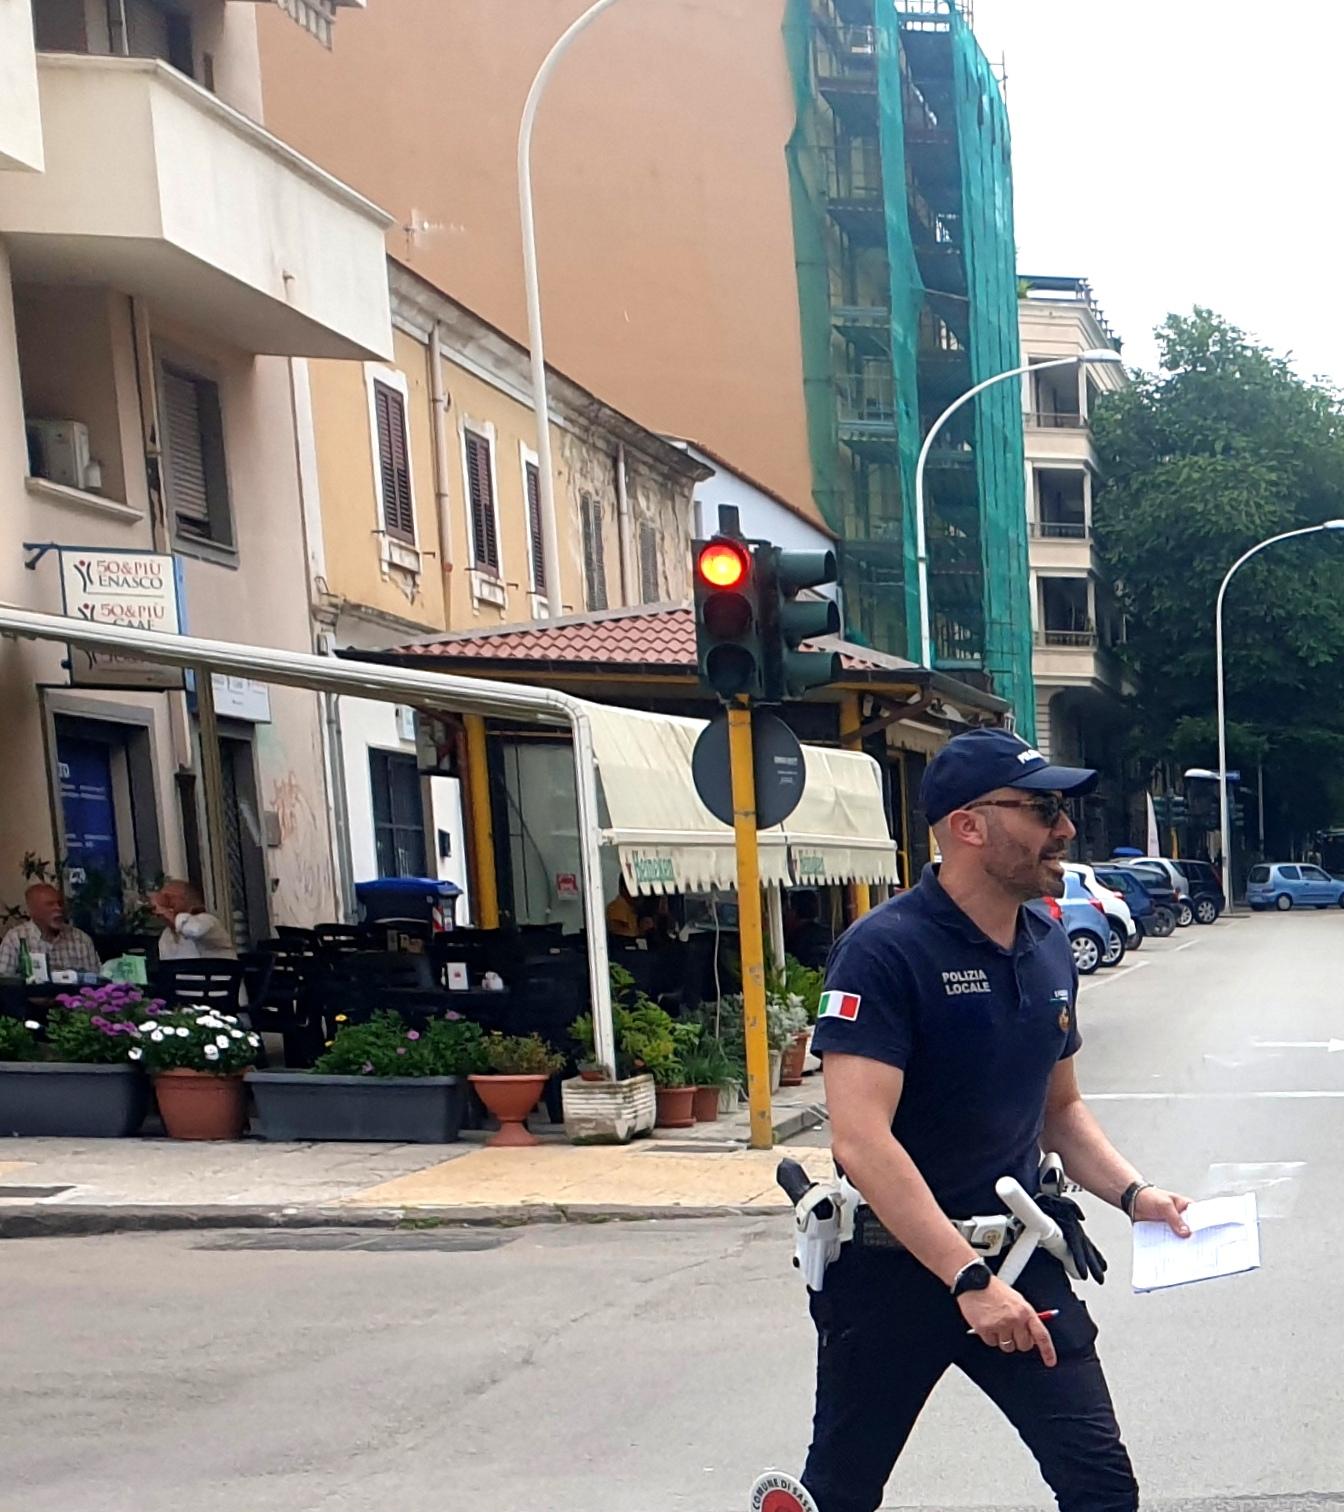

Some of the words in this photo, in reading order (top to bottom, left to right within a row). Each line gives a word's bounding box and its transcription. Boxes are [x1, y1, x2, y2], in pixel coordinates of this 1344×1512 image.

[96, 558, 161, 576] 50&PIÙ
[98, 574, 163, 589] ENASCO
[100, 602, 165, 619] 50&PIÙ
[942, 969, 988, 983] POLIZIA
[945, 982, 991, 995] LOCALE
[753, 1478, 779, 1510] COMUNE
[781, 1479, 791, 1491] DI
